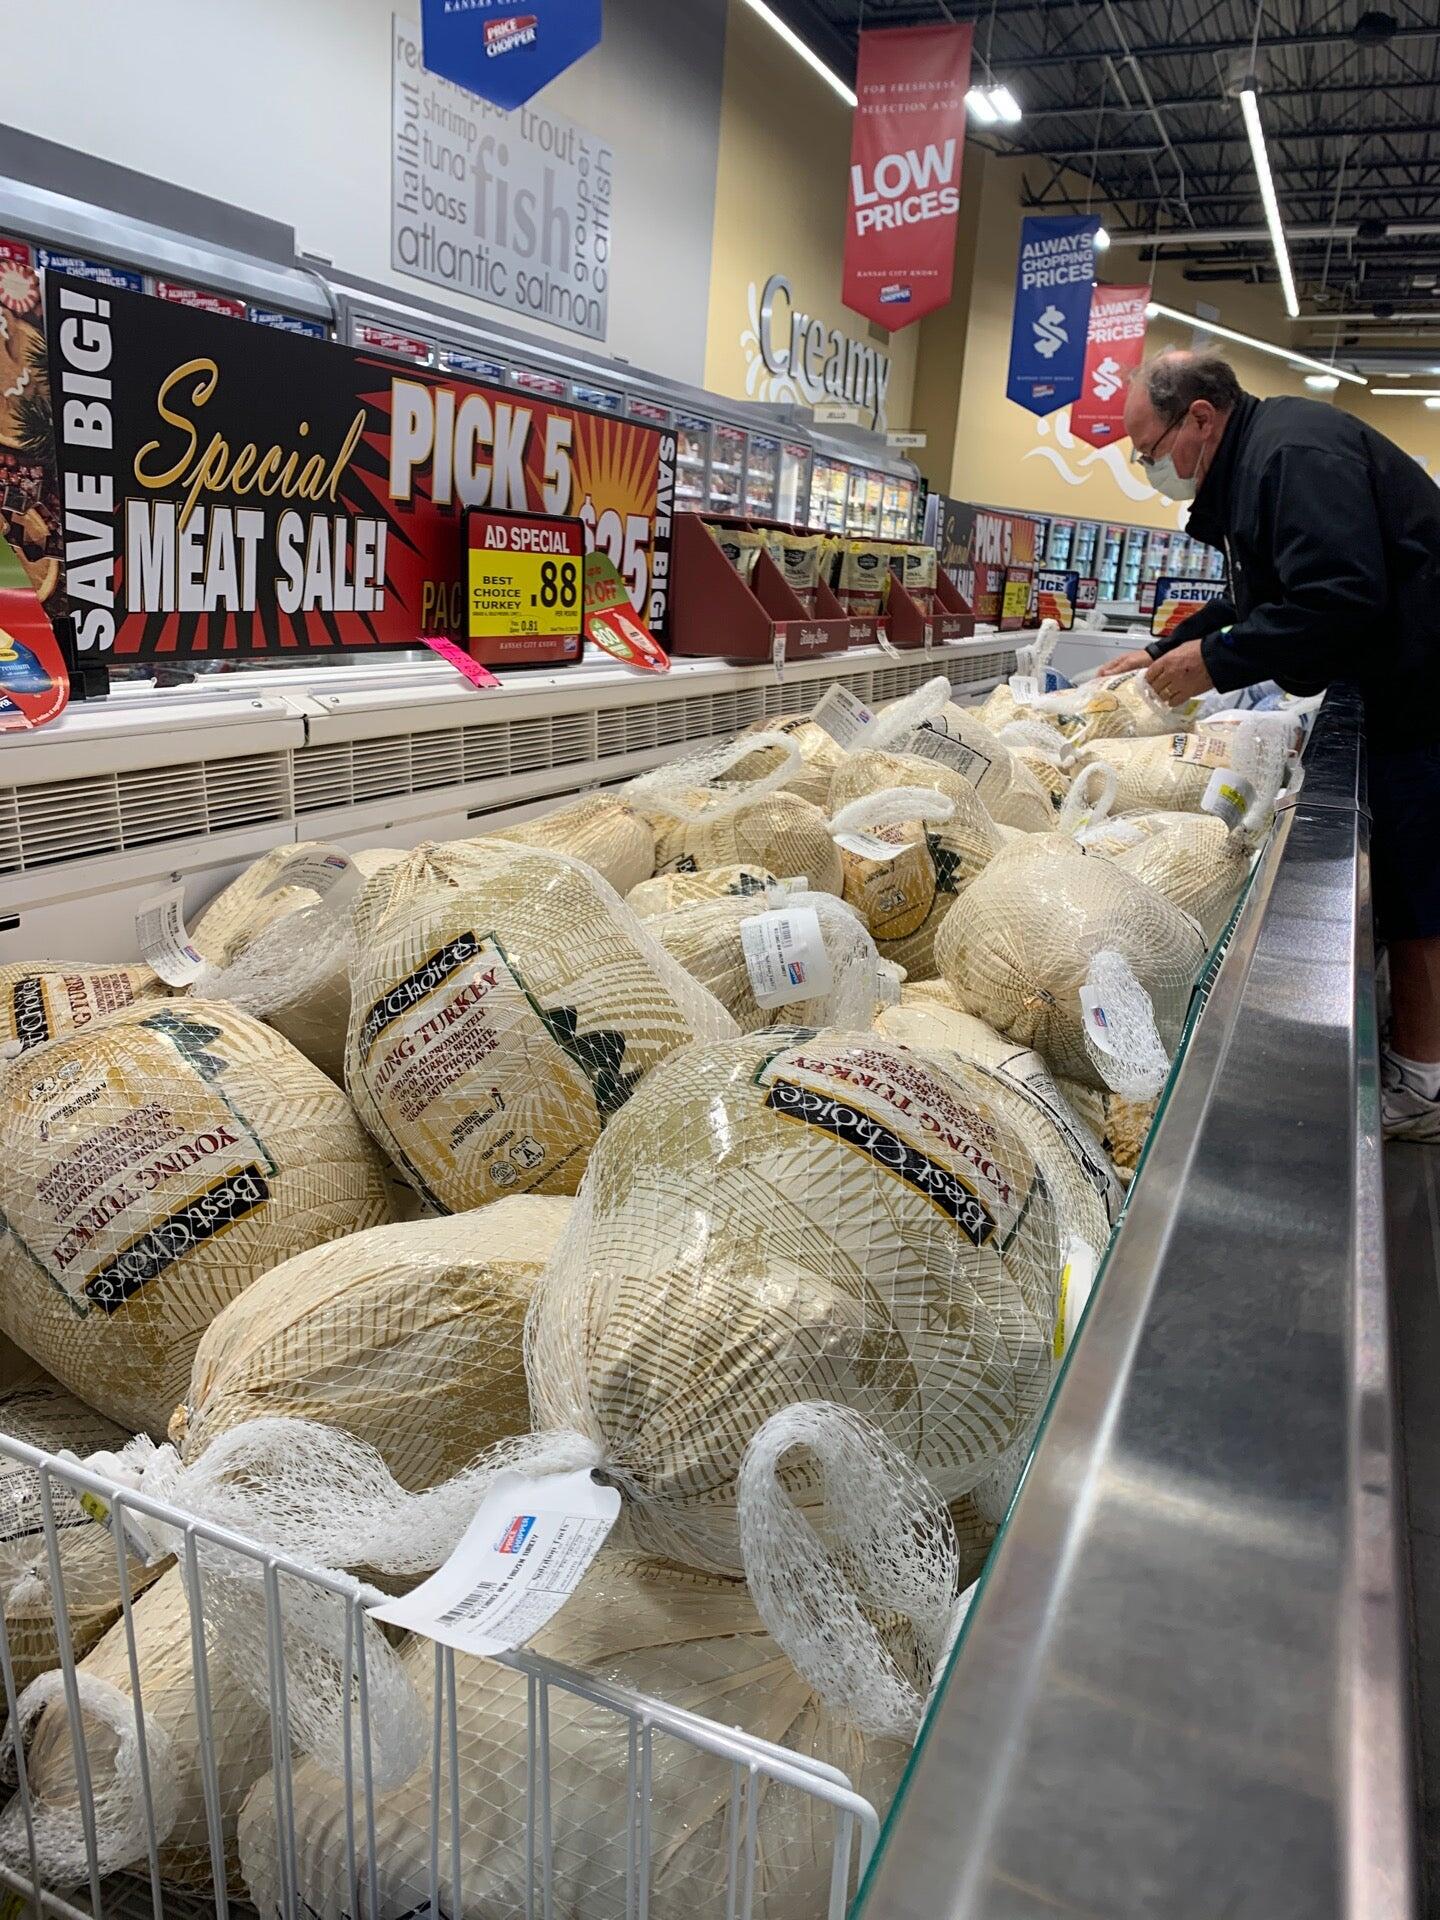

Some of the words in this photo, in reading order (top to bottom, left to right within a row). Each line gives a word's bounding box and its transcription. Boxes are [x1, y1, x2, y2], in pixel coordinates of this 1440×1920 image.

[486, 27, 536, 58] CHOPPER
[487, 18, 518, 40] PRICE
[397, 35, 428, 74] re
[862, 102, 926, 114] SELECTION
[933, 100, 959, 111] AND
[864, 82, 886, 94] FOR
[422, 92, 478, 153] shrimp
[520, 105, 575, 166] trout
[397, 80, 418, 215] halibut
[423, 130, 465, 181] tuna
[852, 138, 956, 206] LOW
[421, 175, 467, 224] bass
[472, 135, 570, 274] fish
[574, 138, 590, 282] grouper
[592, 149, 612, 293] catfish
[856, 187, 960, 236] PRICES
[51, 256, 86, 268] ALWAYS
[1022, 233, 1094, 259] ALWAYS
[1022, 250, 1094, 272] CHOPPING
[66, 267, 112, 276] CHOPPING
[168, 288, 197, 298] ALWAYS
[398, 222, 508, 297] atlantic
[515, 269, 600, 332] salmon
[1022, 263, 1094, 290] PRICES
[760, 274, 891, 430] Creamy
[1088, 324, 1145, 344] PRICES
[60, 288, 114, 450] BIG!
[134, 358, 366, 534] Special
[390, 377, 532, 511] PICK
[543, 414, 572, 515] 5
[655, 435, 675, 538] SAVE
[64, 475, 116, 650] SAVE
[127, 498, 264, 612] MEAT
[276, 508, 388, 614] SALE!
[484, 524, 508, 549] AD
[511, 526, 570, 554] SPECIAL
[976, 514, 1002, 564] PICK
[1004, 520, 1012, 566] 5
[474, 588, 520, 598] CHOICE
[483, 576, 512, 585] BEST
[531, 560, 577, 608] .88
[595, 579, 617, 603] OFF
[652, 552, 670, 630] BIG!
[474, 600, 522, 610] TURKEY
[521, 620, 538, 632] 0.81
[500, 642, 522, 650] KANSAS
[387, 940, 474, 1014] Choice
[20, 976, 43, 1031] Choice
[414, 967, 500, 1043] TURKEY
[410, 1070, 443, 1101] SODIUM
[417, 1048, 455, 1081] TURKEY
[424, 1068, 465, 1103] NATURAL
[787, 1054, 914, 1118] TURKEY
[63, 1094, 100, 1119] INCLUDES
[450, 1110, 480, 1136] INCLUDES
[474, 1107, 496, 1128] TIMER
[779, 1084, 909, 1168] Choice
[124, 1124, 187, 1165] CONTAINS
[135, 1124, 238, 1192] YOUNG
[521, 1146, 535, 1160] A
[916, 1112, 1012, 1204] YOUNG
[186, 1170, 262, 1237] Best
[910, 1157, 987, 1235] Best
[48, 1184, 140, 1272] TURKEY
[87, 1216, 197, 1308] Choice
[503, 1530, 519, 1552] PRICE
[507, 1557, 526, 1581] FROZEN
[522, 1534, 539, 1557] TURKEY
[510, 1516, 532, 1552] CHOPPER
[552, 1523, 570, 1546] Facts
